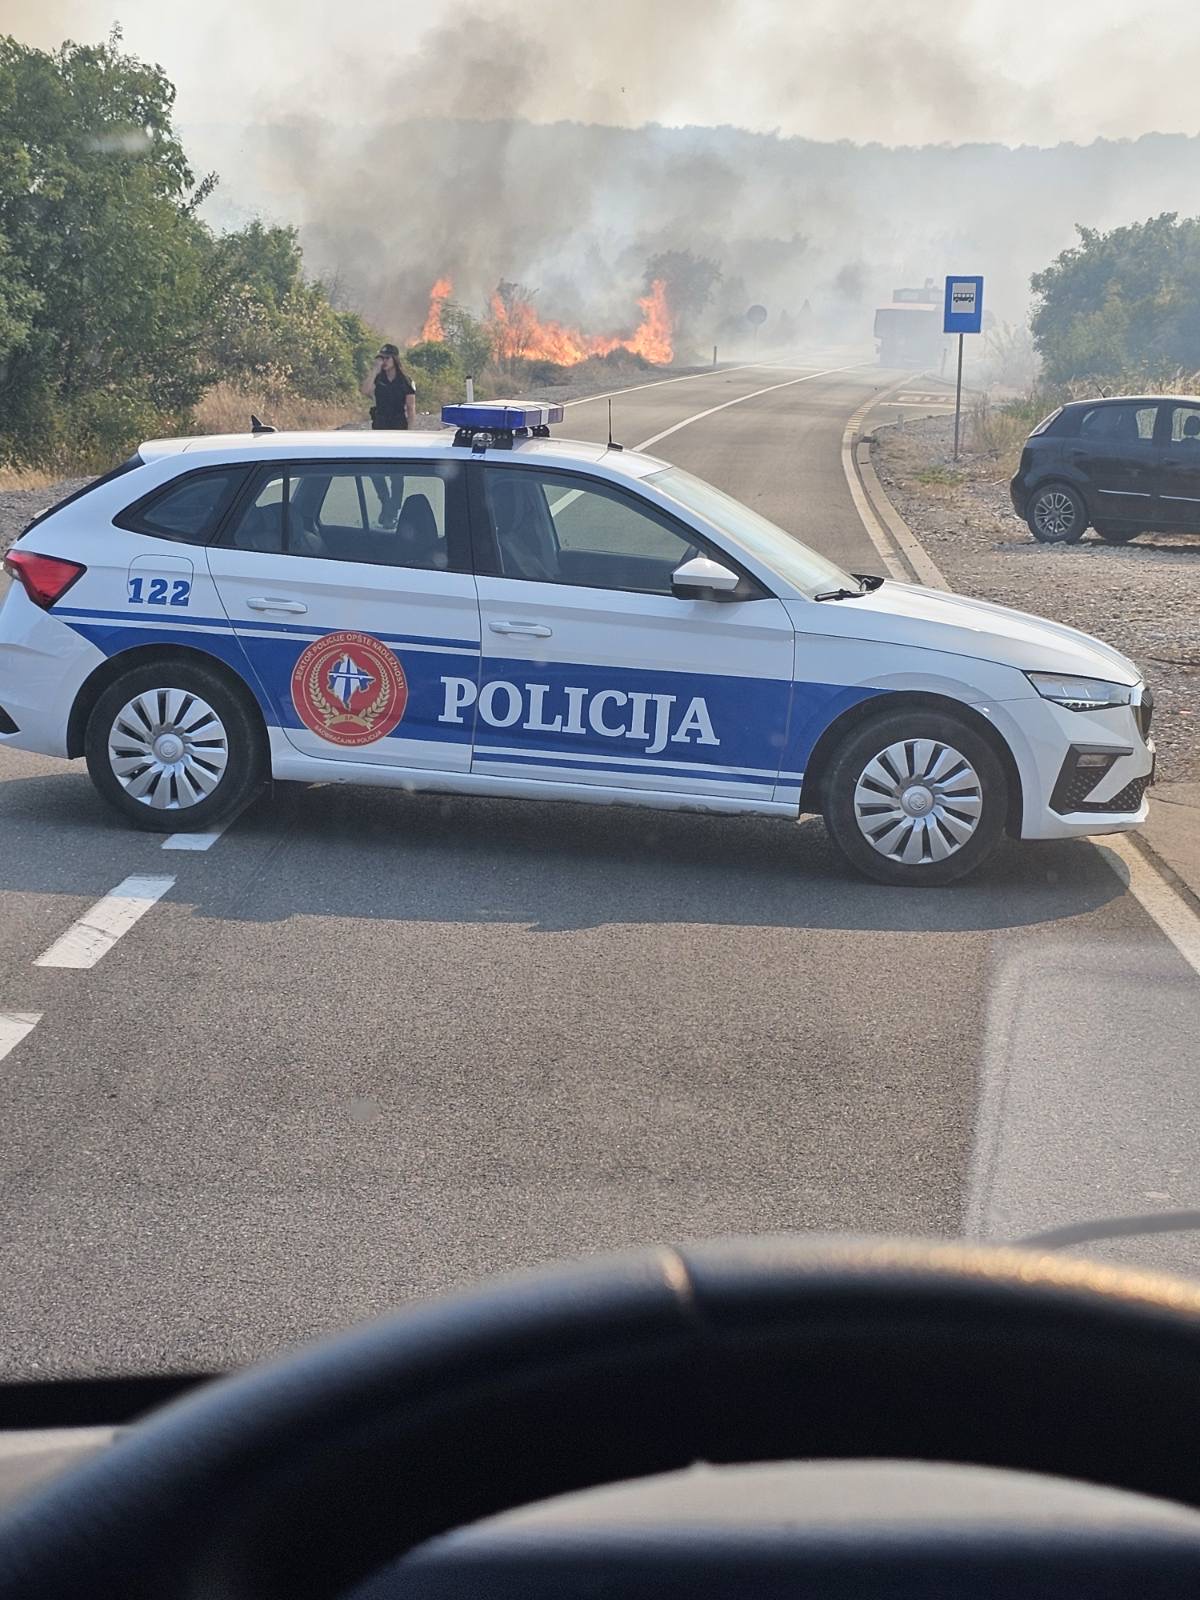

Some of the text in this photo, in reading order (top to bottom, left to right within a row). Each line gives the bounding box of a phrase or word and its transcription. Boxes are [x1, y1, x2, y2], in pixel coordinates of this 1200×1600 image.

[128, 578, 190, 606] 122
[294, 650, 315, 681] SEKTOR
[438, 676, 720, 753] POLICIJA
